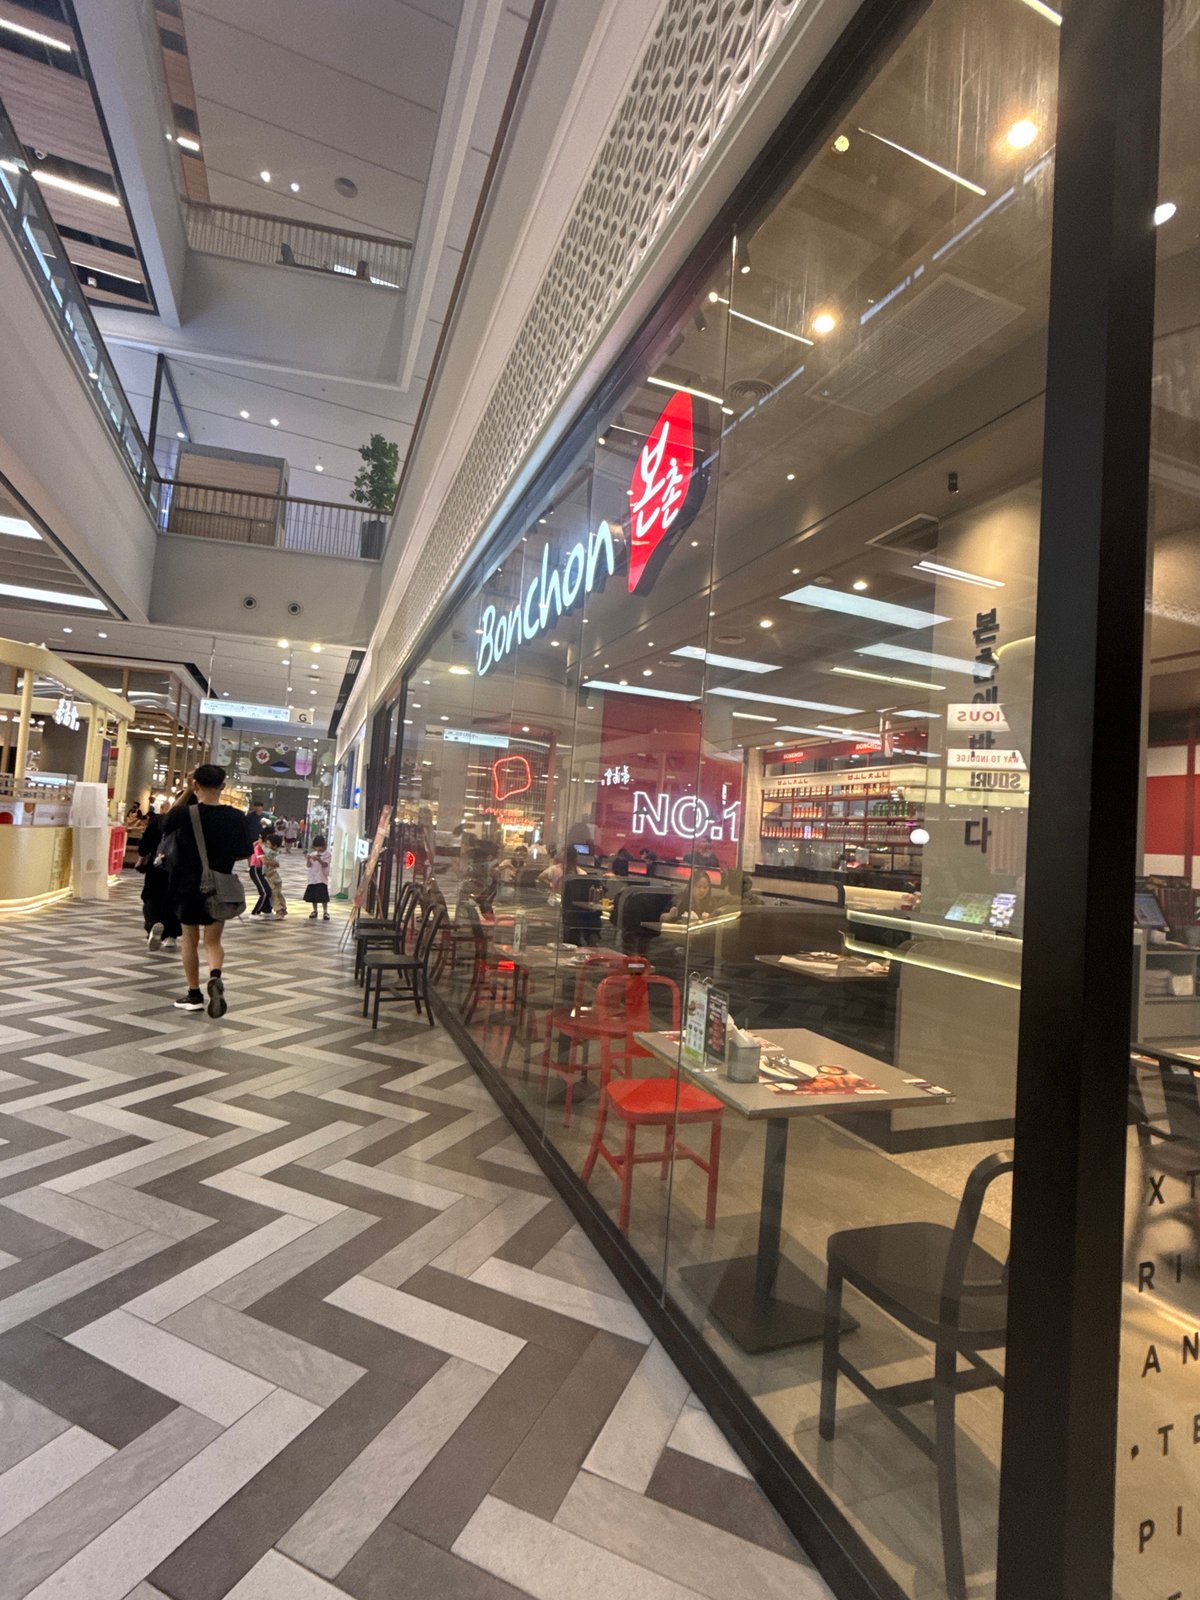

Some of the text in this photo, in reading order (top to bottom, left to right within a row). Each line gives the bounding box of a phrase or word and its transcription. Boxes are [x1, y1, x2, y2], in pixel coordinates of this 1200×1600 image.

[632, 420, 684, 539] 본촌
[475, 519, 614, 677] Bonchon
[298, 713, 308, 722] G
